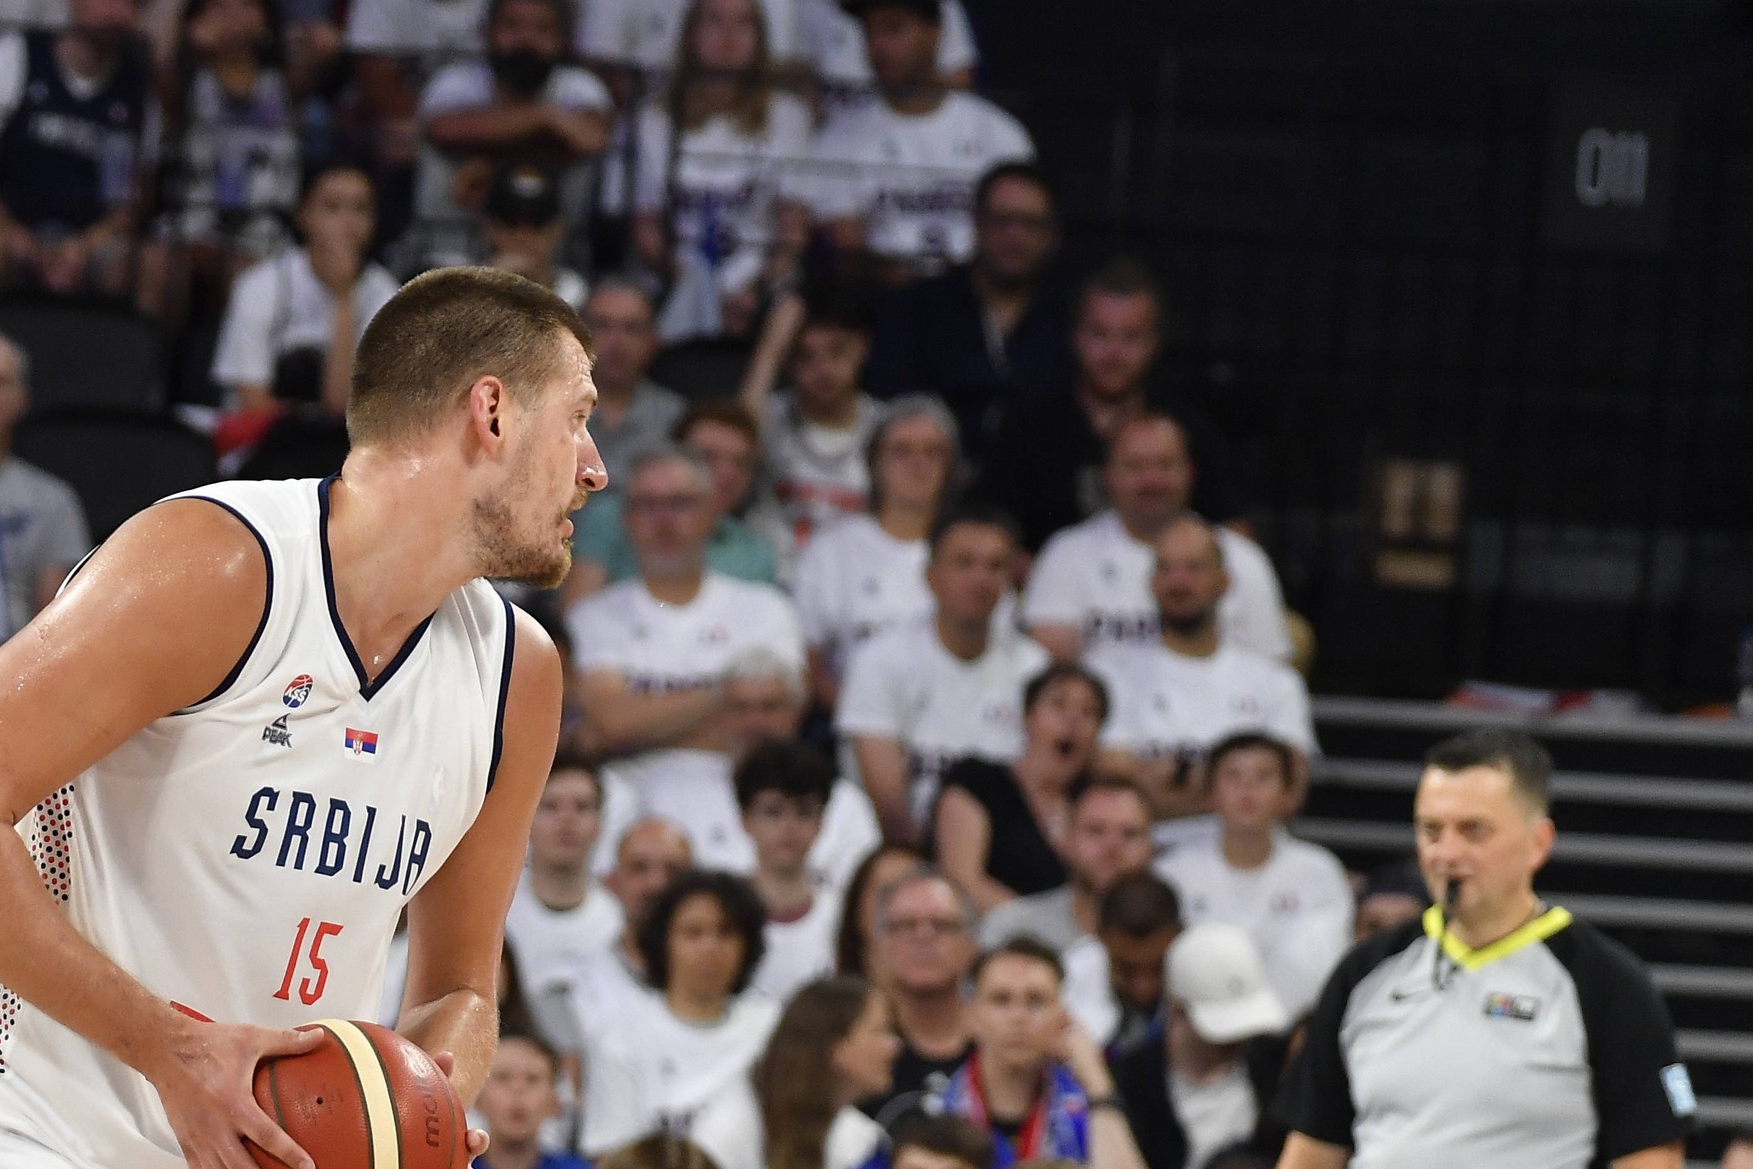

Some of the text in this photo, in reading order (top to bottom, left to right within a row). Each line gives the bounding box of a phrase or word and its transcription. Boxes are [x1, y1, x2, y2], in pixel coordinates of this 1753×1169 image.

[261, 726, 293, 748] PEAK
[229, 786, 432, 896] SRBIJA
[272, 917, 344, 1006] 15
